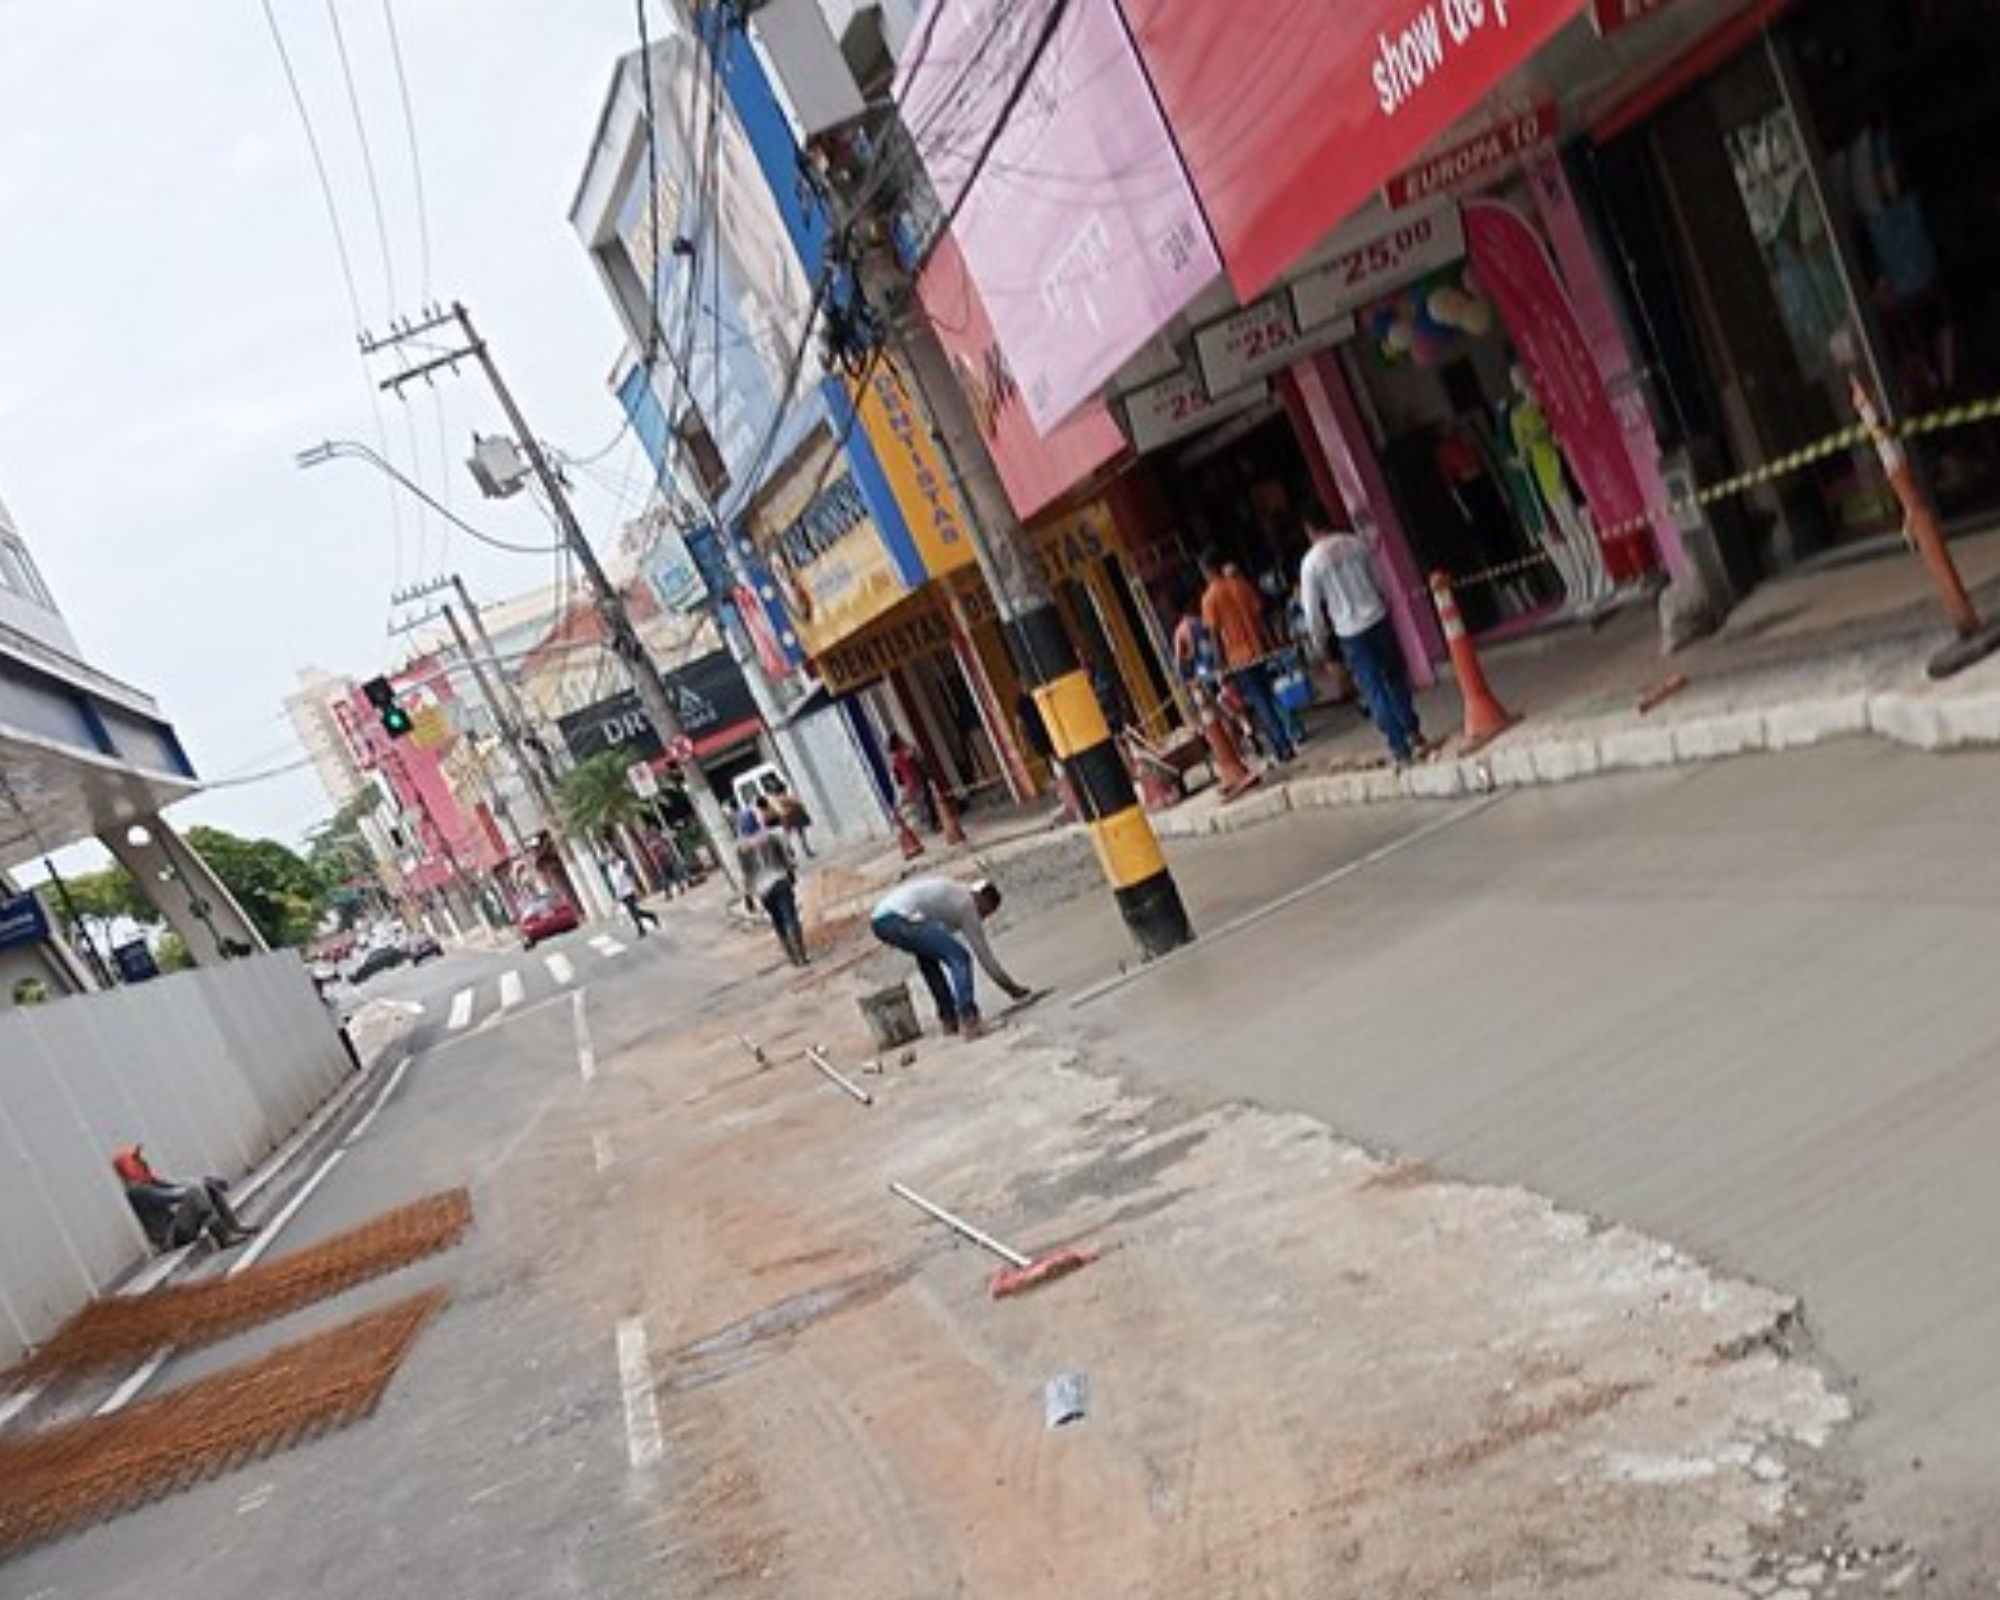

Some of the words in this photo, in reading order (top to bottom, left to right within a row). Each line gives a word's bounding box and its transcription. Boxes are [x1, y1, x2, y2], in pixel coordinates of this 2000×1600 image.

[1372, 3, 1443, 116] show
[1406, 136, 1501, 198] EUROPA
[1341, 217, 1432, 285] 25,00
[1244, 319, 1295, 359] 25,
[829, 610, 946, 681] DENTISTAS
